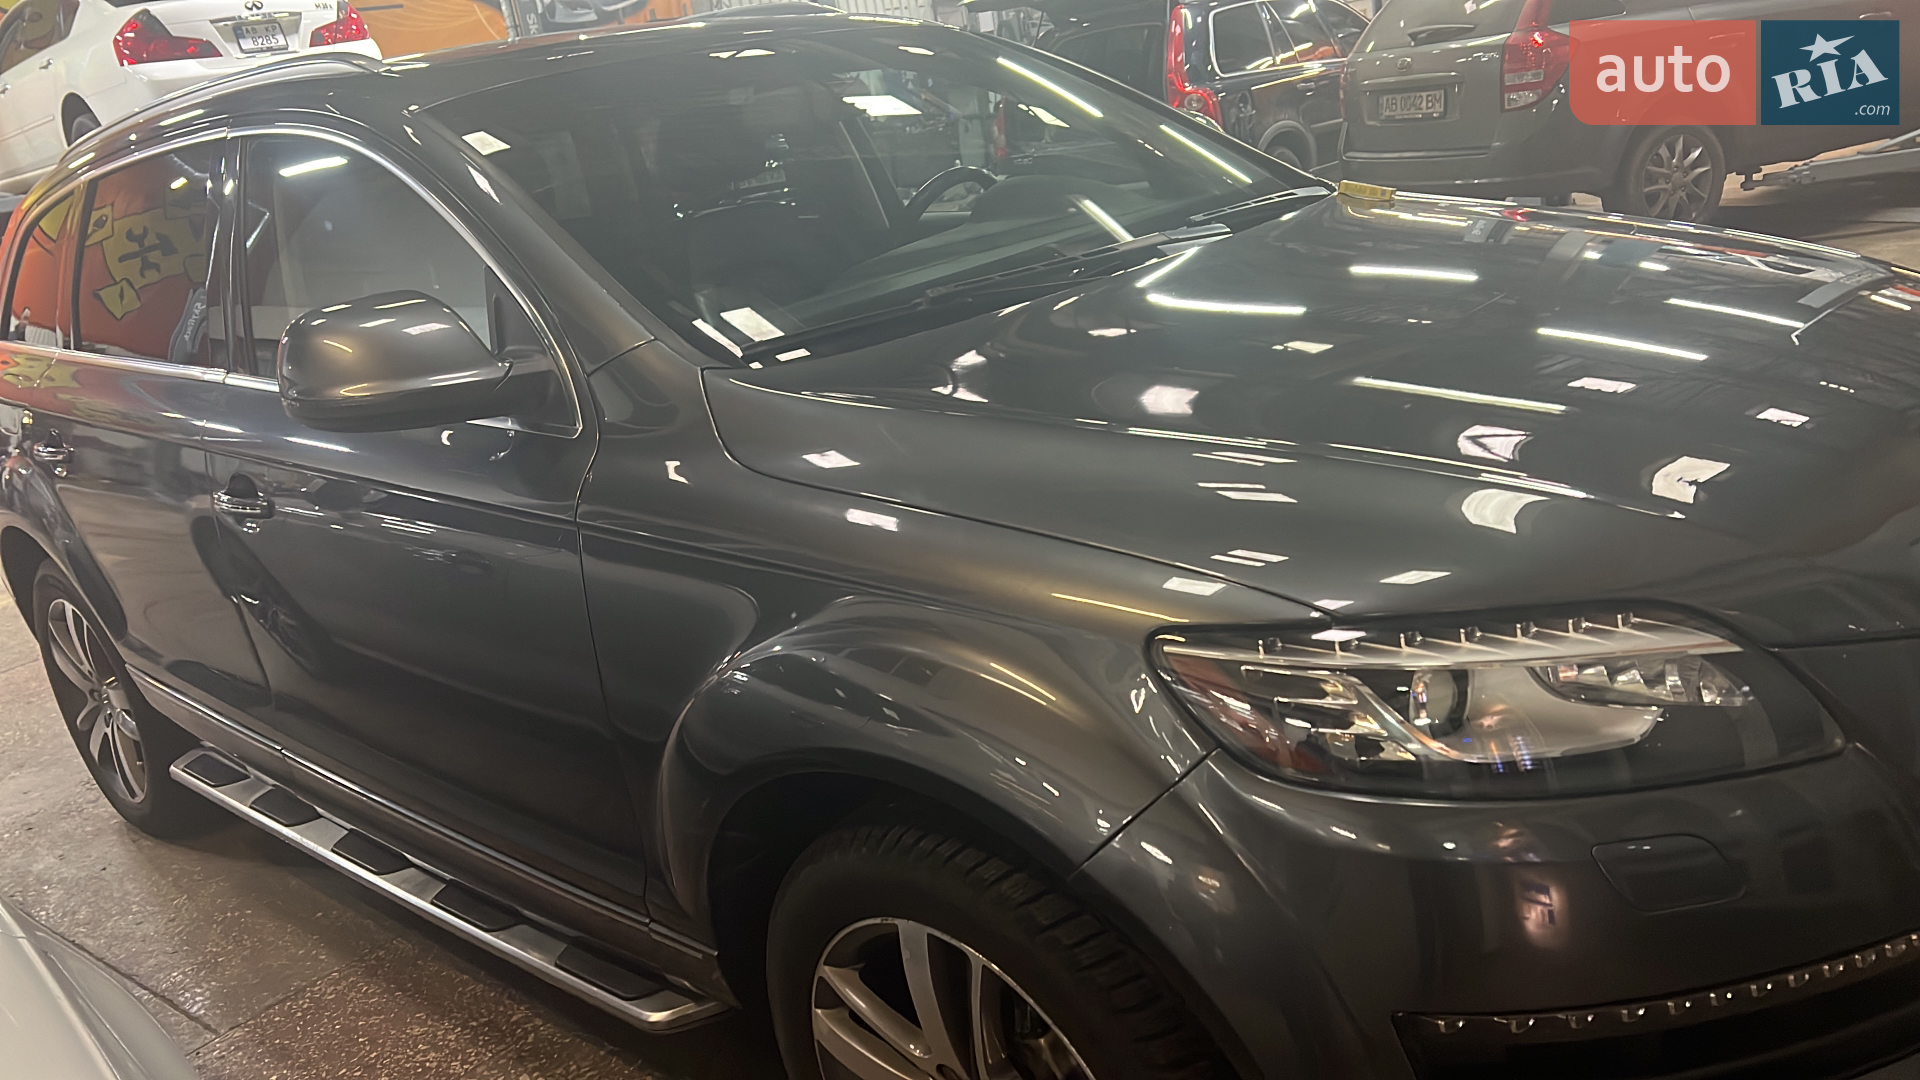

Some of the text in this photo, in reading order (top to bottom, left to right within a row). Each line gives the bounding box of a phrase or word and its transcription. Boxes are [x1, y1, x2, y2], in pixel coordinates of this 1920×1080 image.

[526, 12, 538, 35] Sk
[251, 34, 279, 46] 8285
[1385, 97, 1398, 113] AB
[1425, 93, 1442, 110] BM
